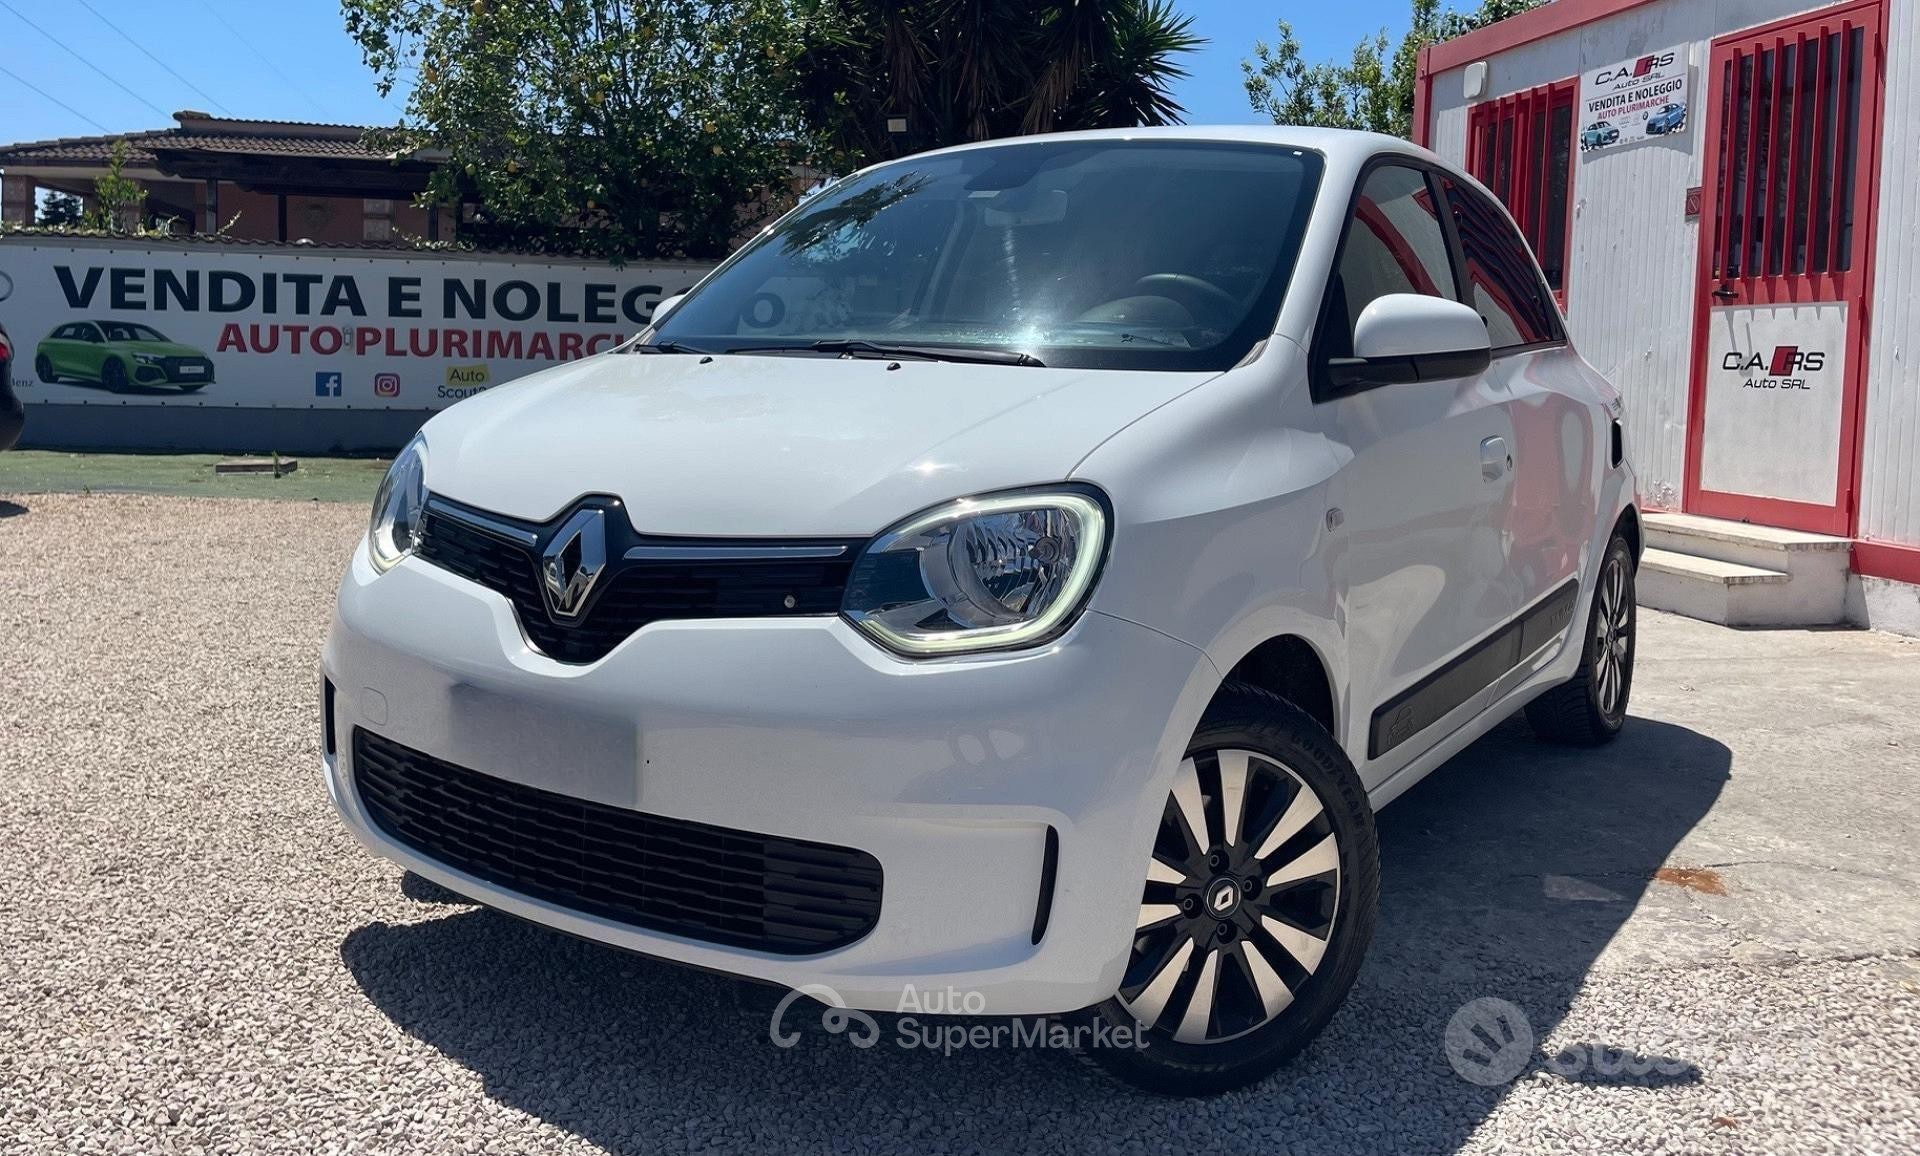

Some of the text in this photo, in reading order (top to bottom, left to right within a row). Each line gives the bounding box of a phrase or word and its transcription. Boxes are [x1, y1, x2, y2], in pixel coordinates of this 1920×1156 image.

[1588, 78, 1683, 113] VENDITA E NOLEGGIO
[1597, 95, 1670, 121] AUTO PLURIMARCHE
[53, 265, 368, 317] VENDITA
[387, 276, 423, 318] E
[216, 323, 343, 356] AUTO
[449, 368, 485, 382] Auto
[1743, 378, 1811, 390] Auto SRL
